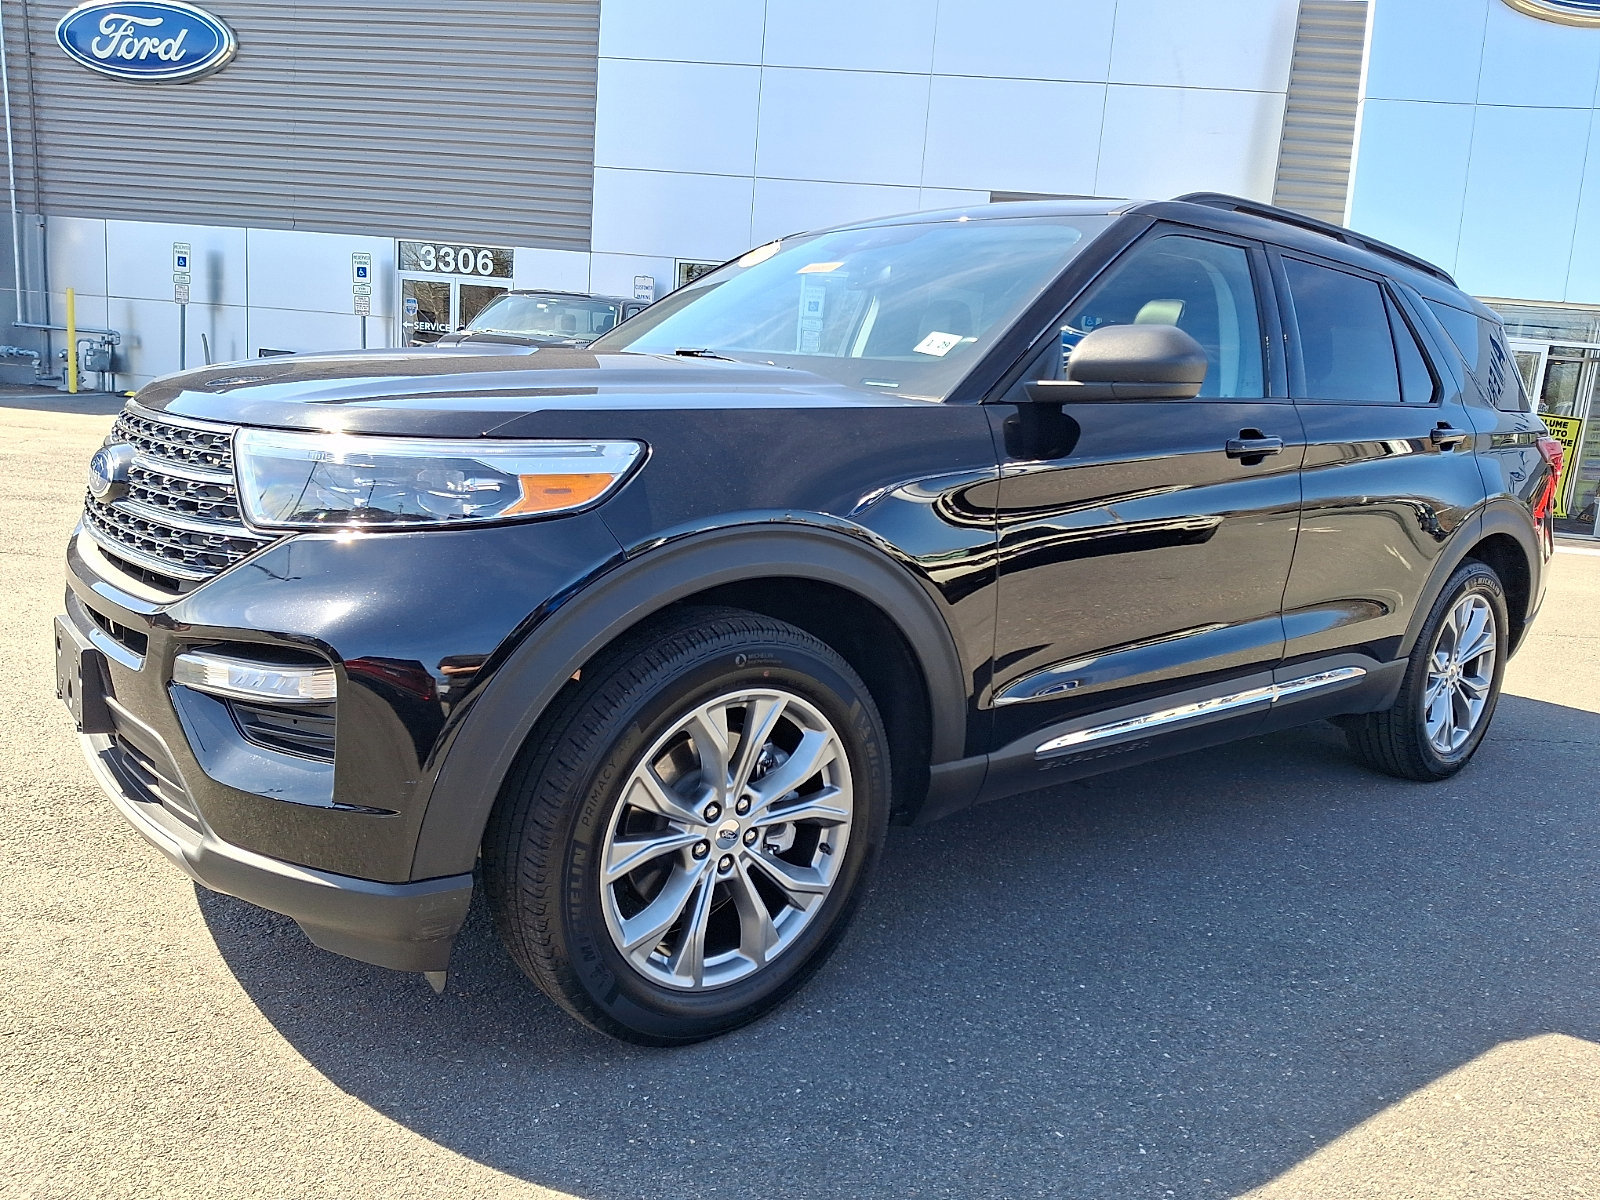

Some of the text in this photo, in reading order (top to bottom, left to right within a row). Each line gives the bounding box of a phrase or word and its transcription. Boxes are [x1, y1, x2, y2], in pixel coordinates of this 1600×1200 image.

[91, 13, 189, 62] Ford
[419, 245, 494, 276] 3306
[413, 321, 451, 332] SERVICE
[1541, 418, 1569, 429] LUME
[1477, 577, 1501, 595] MICHELIN
[581, 757, 616, 827] PRIMACY
